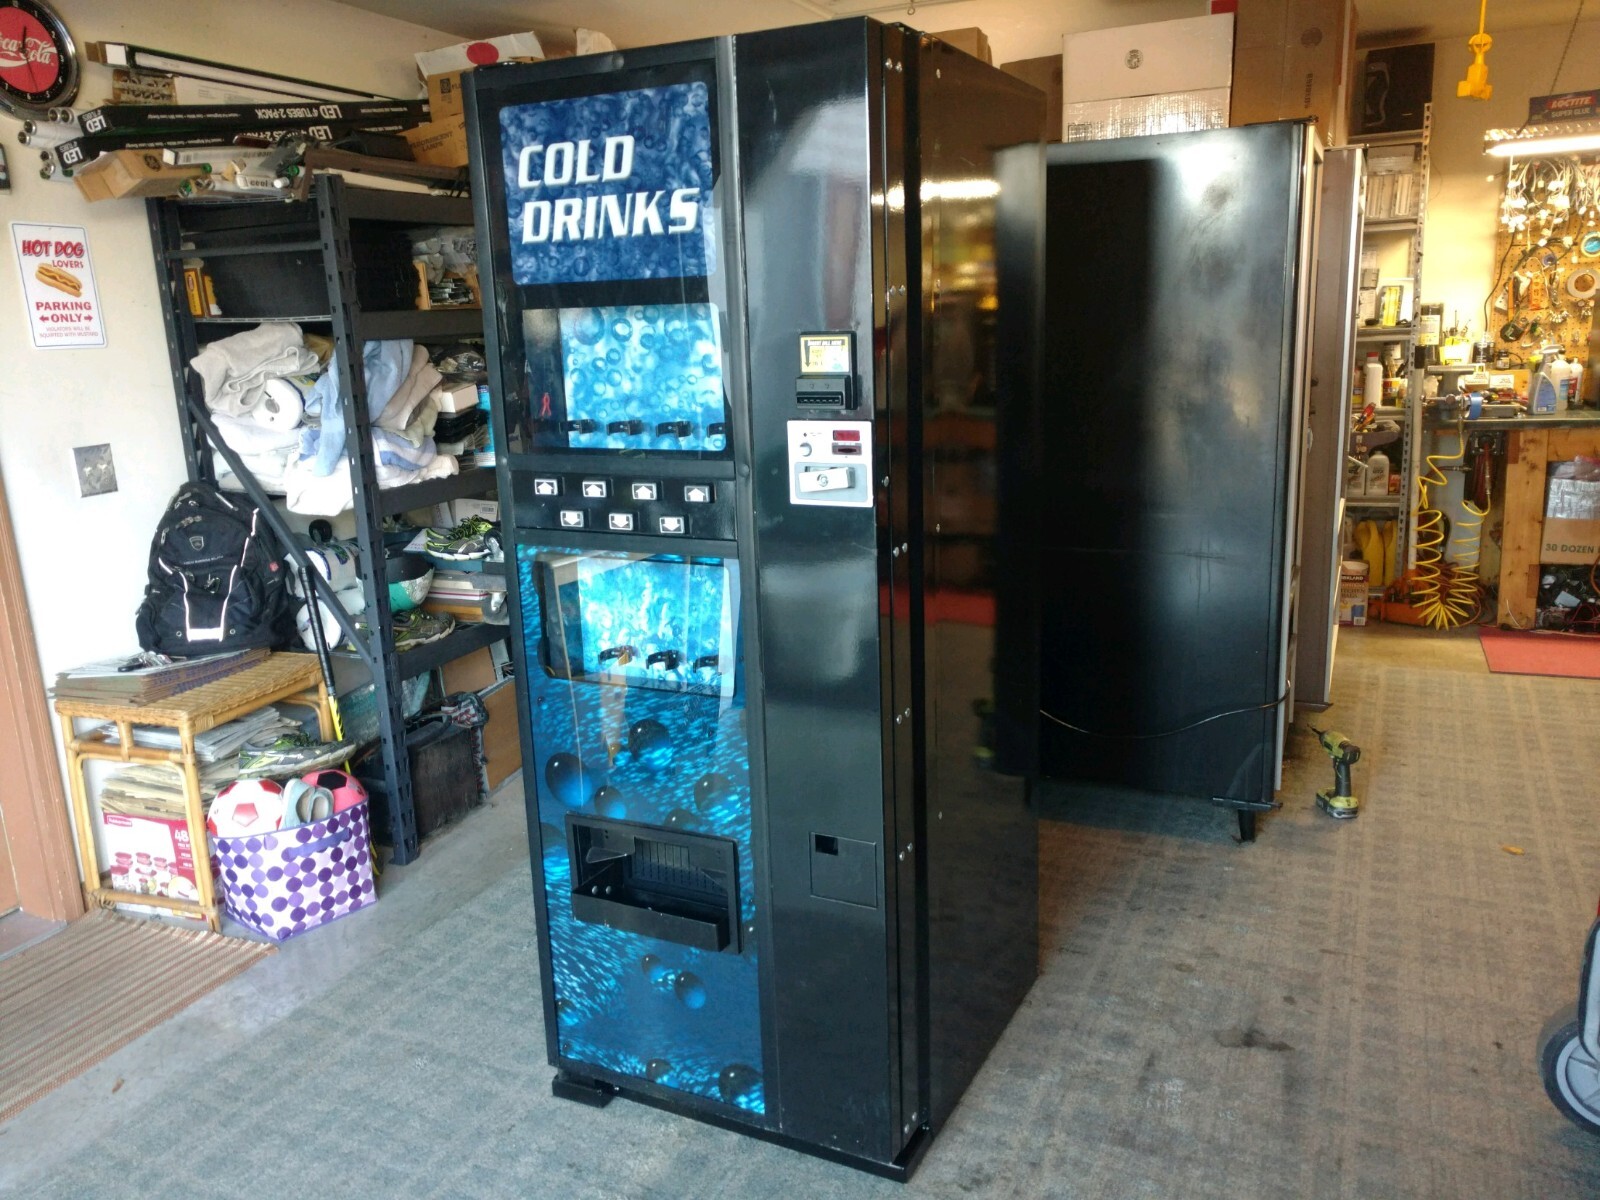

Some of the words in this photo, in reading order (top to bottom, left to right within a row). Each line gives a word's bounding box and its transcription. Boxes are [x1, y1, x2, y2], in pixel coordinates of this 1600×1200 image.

[1551, 96, 1592, 109] LOCTITE
[254, 108, 286, 119] 2-PACK
[319, 104, 342, 119] LED
[86, 115, 107, 133] LED
[309, 125, 333, 140] LED
[63, 147, 83, 164] LED
[518, 134, 635, 189] COLD
[522, 187, 700, 245] DRINKS
[22, 239, 52, 258] HOT
[54, 240, 85, 258] DOG
[52, 260, 84, 269] LOVERS
[35, 301, 92, 311] PARKING
[50, 313, 82, 323] ONLY
[1545, 543, 1558, 552] 30
[1560, 544, 1595, 554] DOZEN
